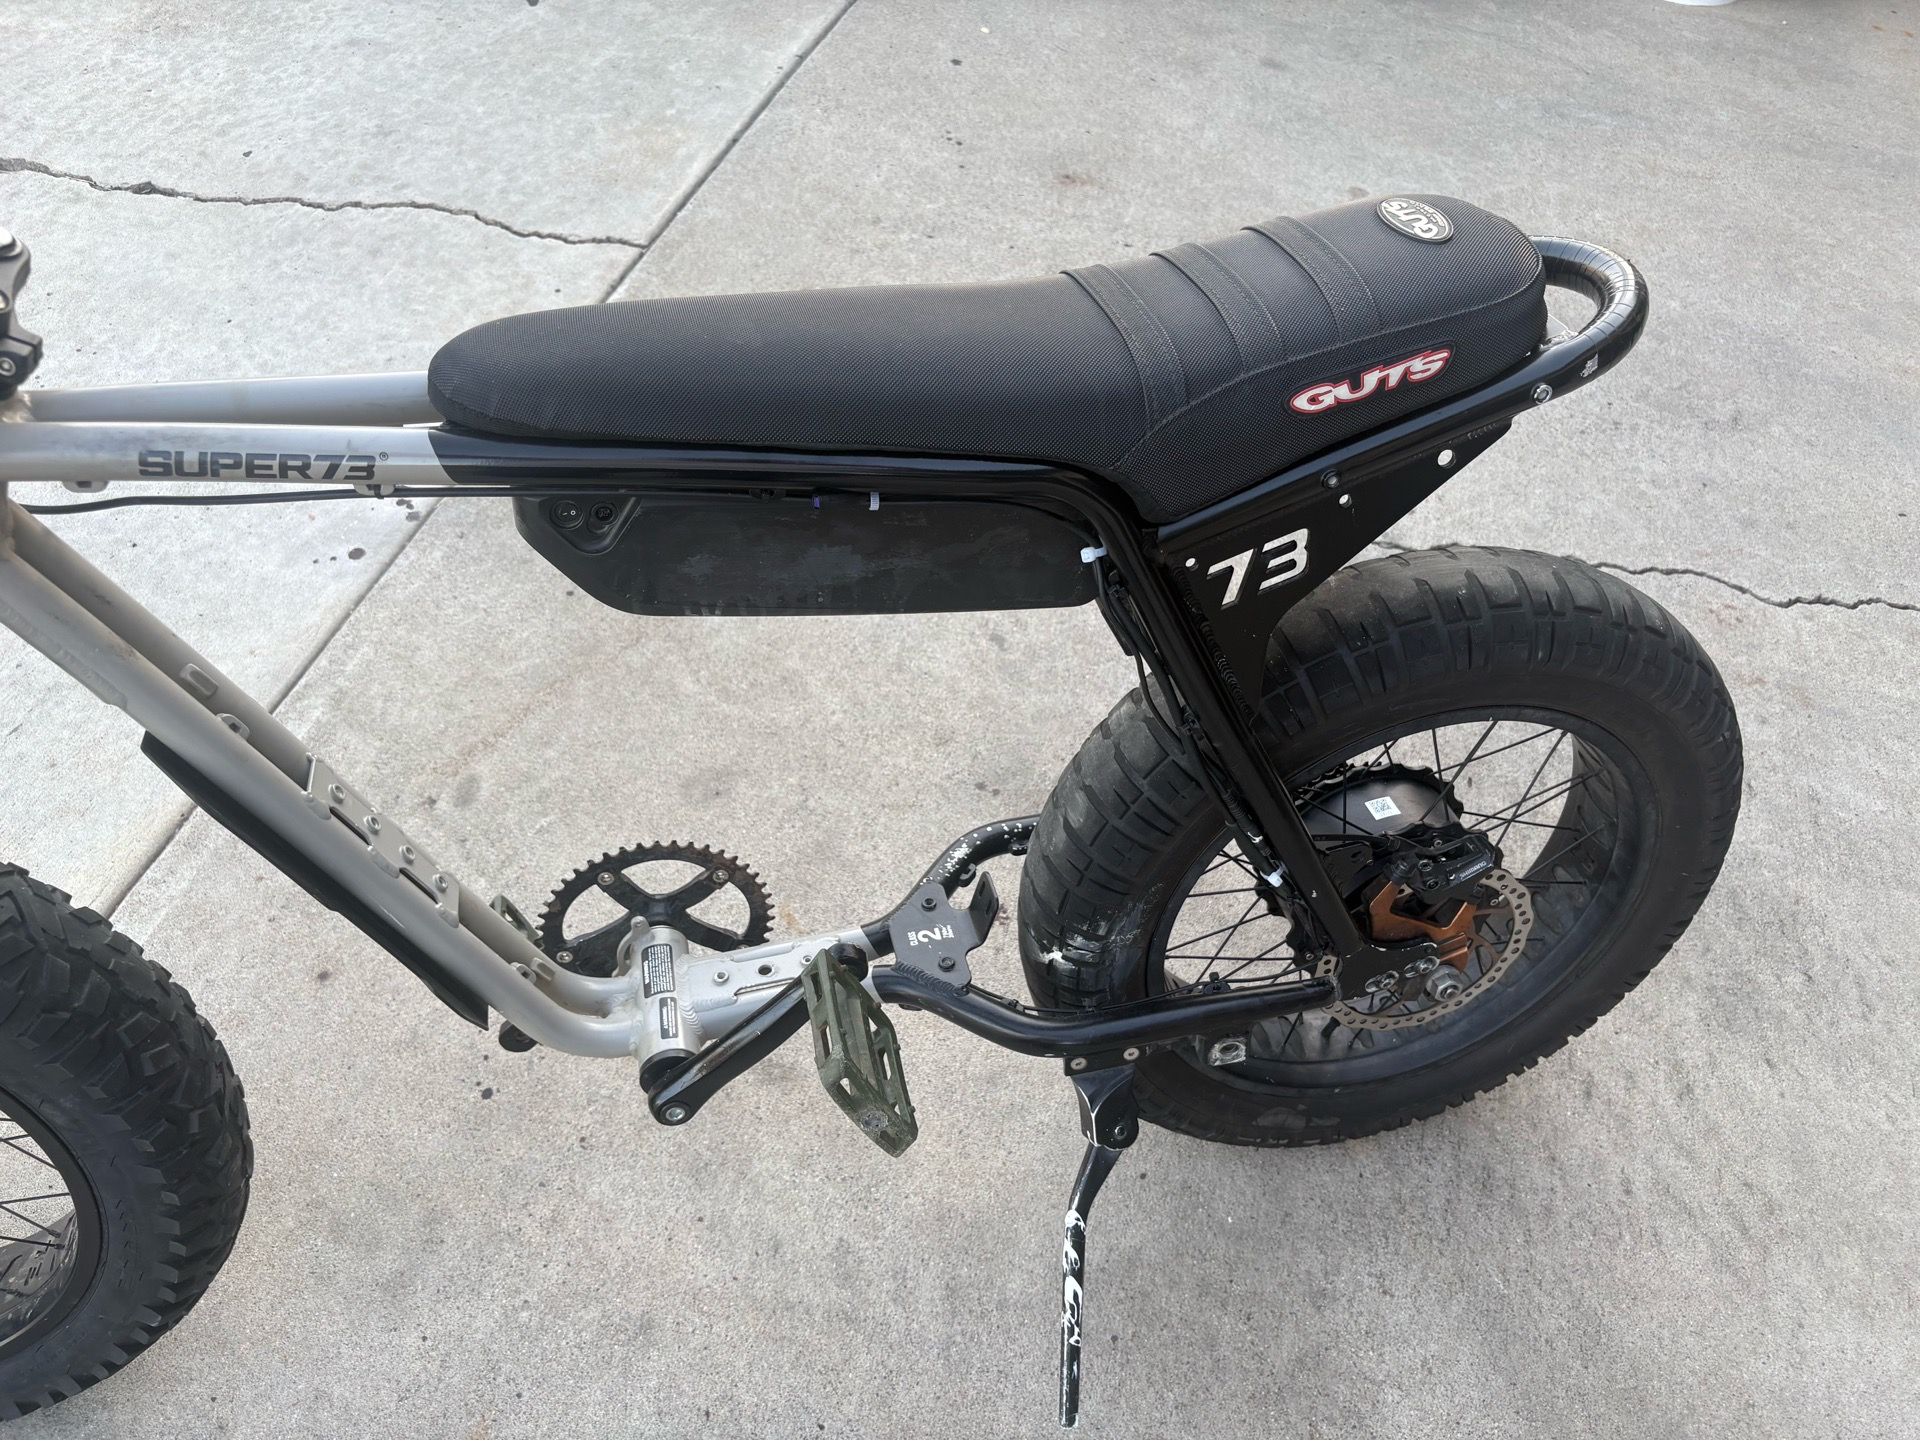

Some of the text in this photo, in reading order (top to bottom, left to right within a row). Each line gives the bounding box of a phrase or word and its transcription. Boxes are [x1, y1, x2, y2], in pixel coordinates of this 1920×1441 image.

[1381, 201, 1438, 238] GUTS
[1290, 349, 1450, 413] GUTS
[1207, 528, 1308, 605] 73
[1459, 860, 1487, 880] SHIMANO
[907, 931, 918, 946] CLASS
[917, 927, 942, 943] 2
